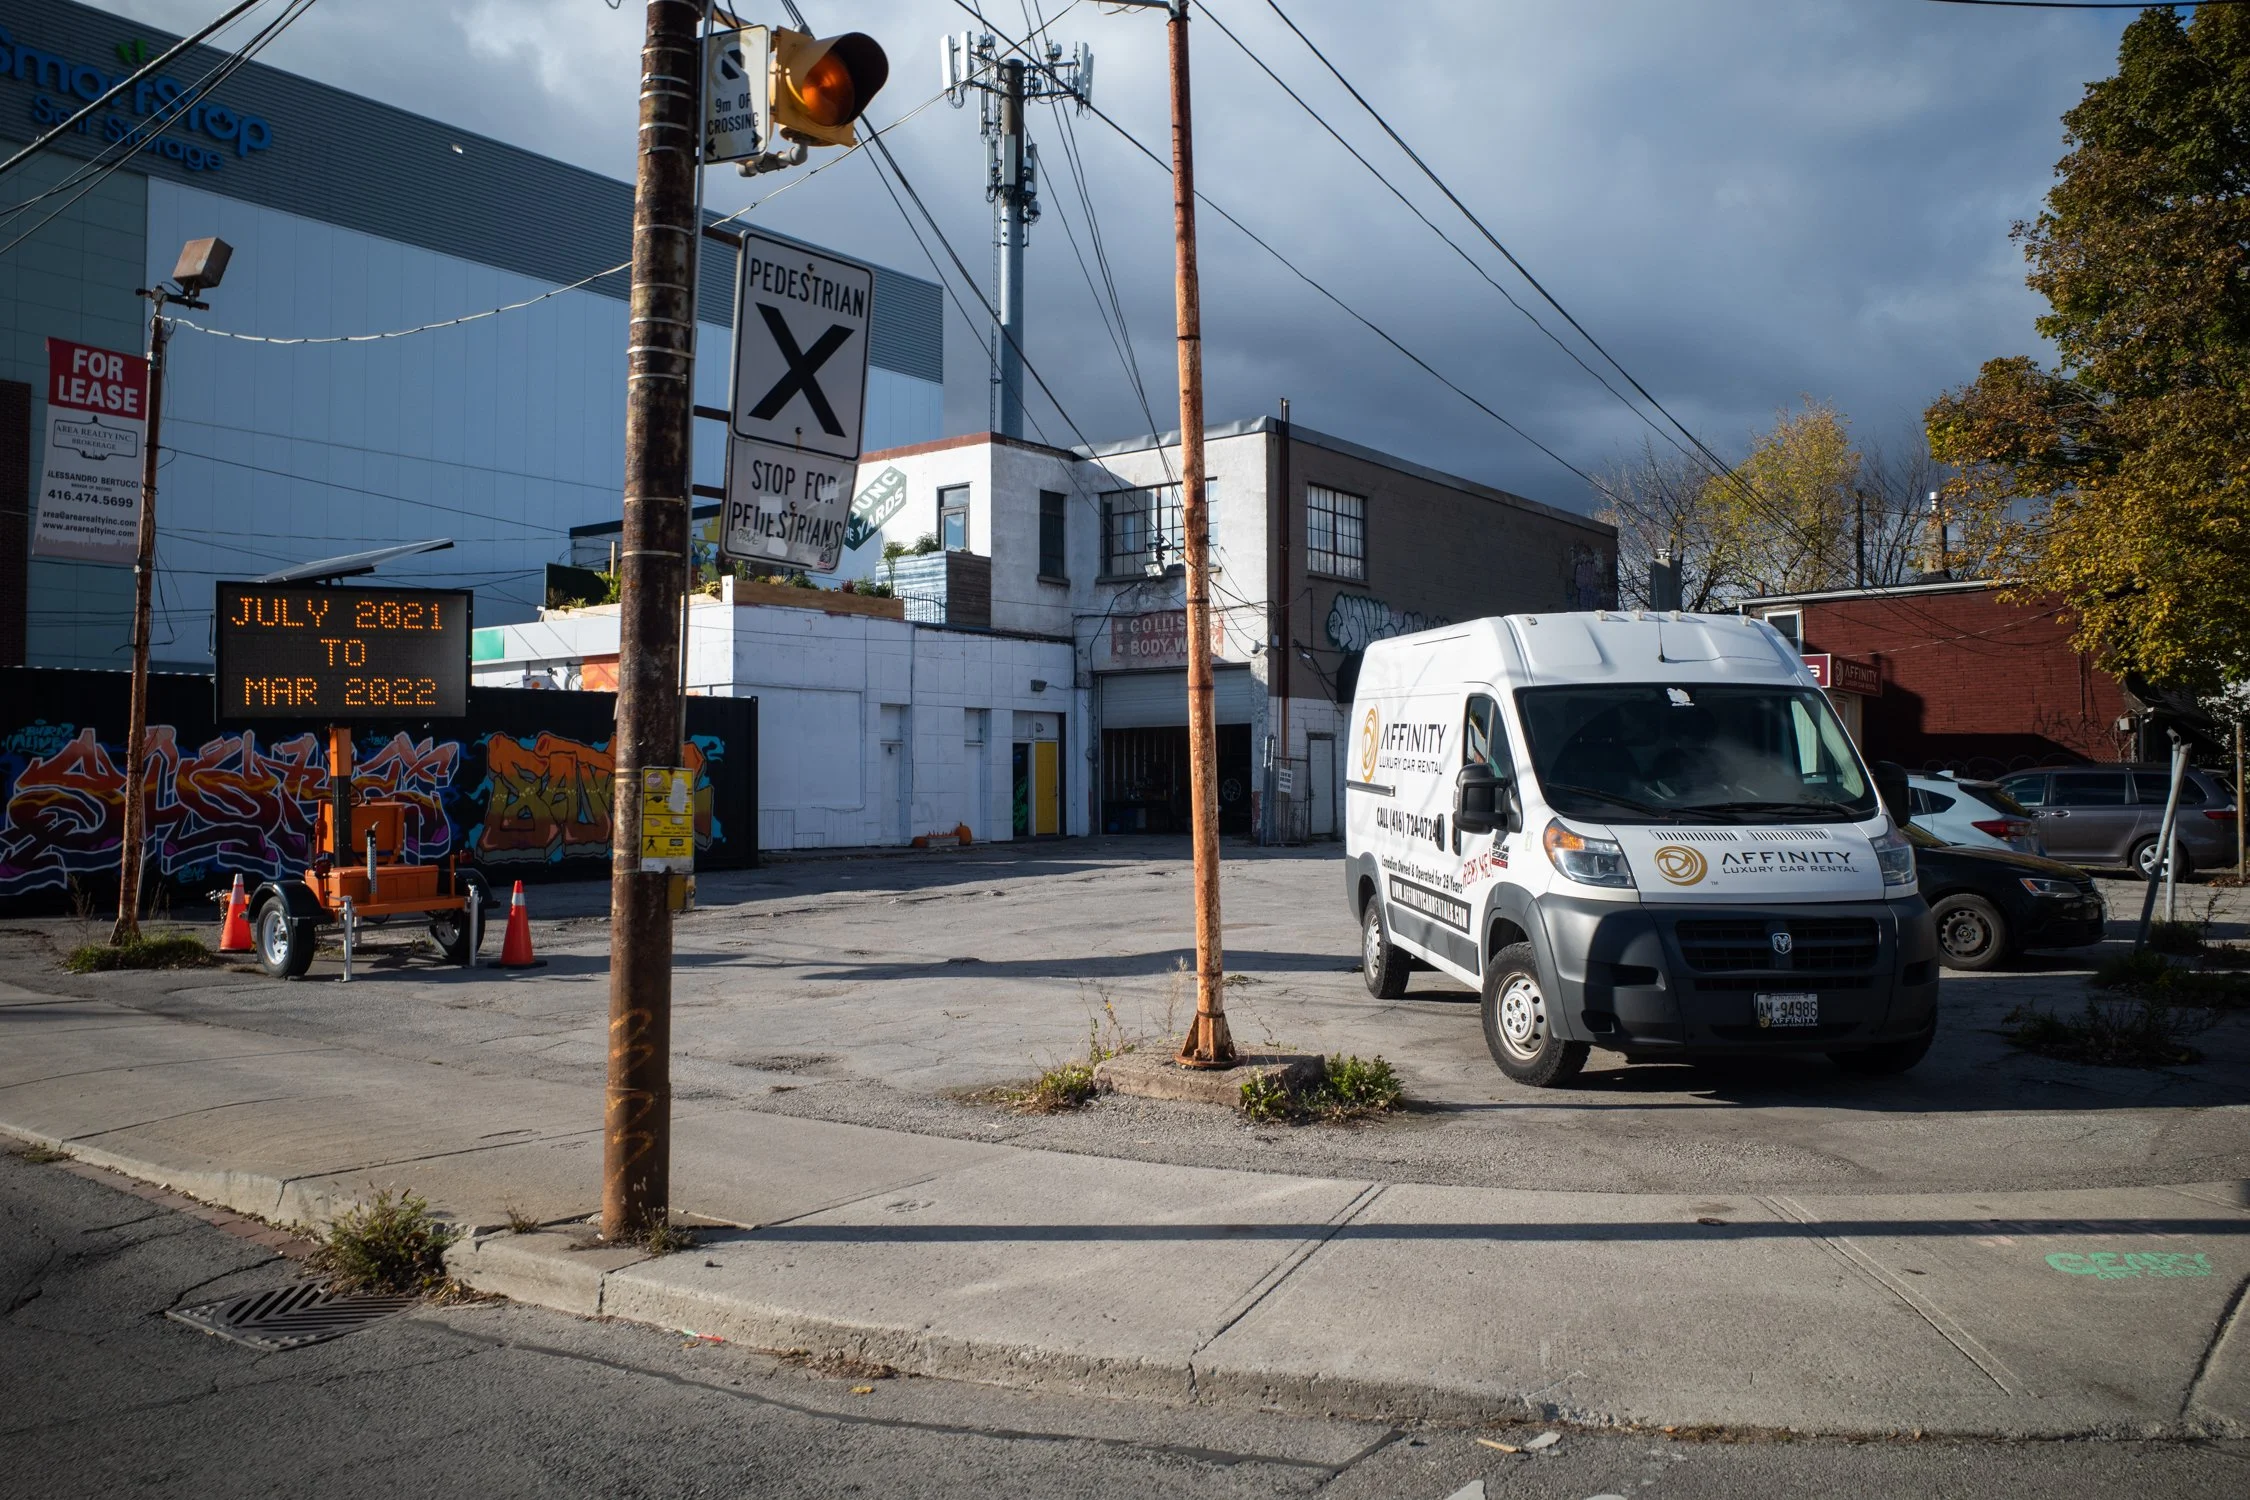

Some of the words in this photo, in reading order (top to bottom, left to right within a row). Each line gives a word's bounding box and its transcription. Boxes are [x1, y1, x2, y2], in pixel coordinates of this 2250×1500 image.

[716, 98, 731, 114] 9m
[738, 92, 751, 109] OF
[32, 93, 91, 134] Self
[104, 114, 224, 172] Storage
[707, 112, 759, 135] CROSSING
[750, 258, 864, 318] PEDESTRIAN
[73, 348, 123, 382] FOR
[58, 375, 138, 413] LEASE
[56, 424, 79, 436] AREA
[80, 428, 114, 440] REALTY
[71, 438, 117, 450] BROKERAGE
[101, 477, 138, 488] BERTUCCI
[752, 460, 795, 495] STOP
[48, 489, 133, 508] 416.474.5699
[850, 472, 898, 519] JUNC
[731, 502, 842, 549] PEDESTRIANS
[857, 487, 903, 540] YARDS
[42, 521, 135, 537] www.arearealtyinc.com
[231, 597, 328, 627] JULY
[356, 601, 443, 630] 2021
[1130, 615, 1187, 634] COLLIS
[320, 639, 366, 666] TO
[1130, 639, 1171, 656] BODY
[1175, 635, 1219, 654] WK
[1845, 664, 1877, 684] AFFINITY
[245, 677, 317, 705] MAR
[345, 678, 436, 705] 2022
[1381, 723, 1447, 754] AFFINITY
[1379, 756, 1401, 769] LUXURY
[1402, 758, 1415, 771] CAR
[1417, 760, 1443, 775] RENTAL
[1377, 807, 1389, 829] CALL
[1389, 809, 1405, 838] (416)
[1722, 852, 1851, 865] AFFINITY
[1723, 865, 1774, 874] LUXURY
[1811, 865, 1860, 873] RENTAL
[1382, 854, 1398, 872] Canadian
[1398, 860, 1410, 877] Owned
[1411, 863, 1415, 877] &
[1416, 865, 1435, 884] Operated
[1449, 875, 1463, 894] Years
